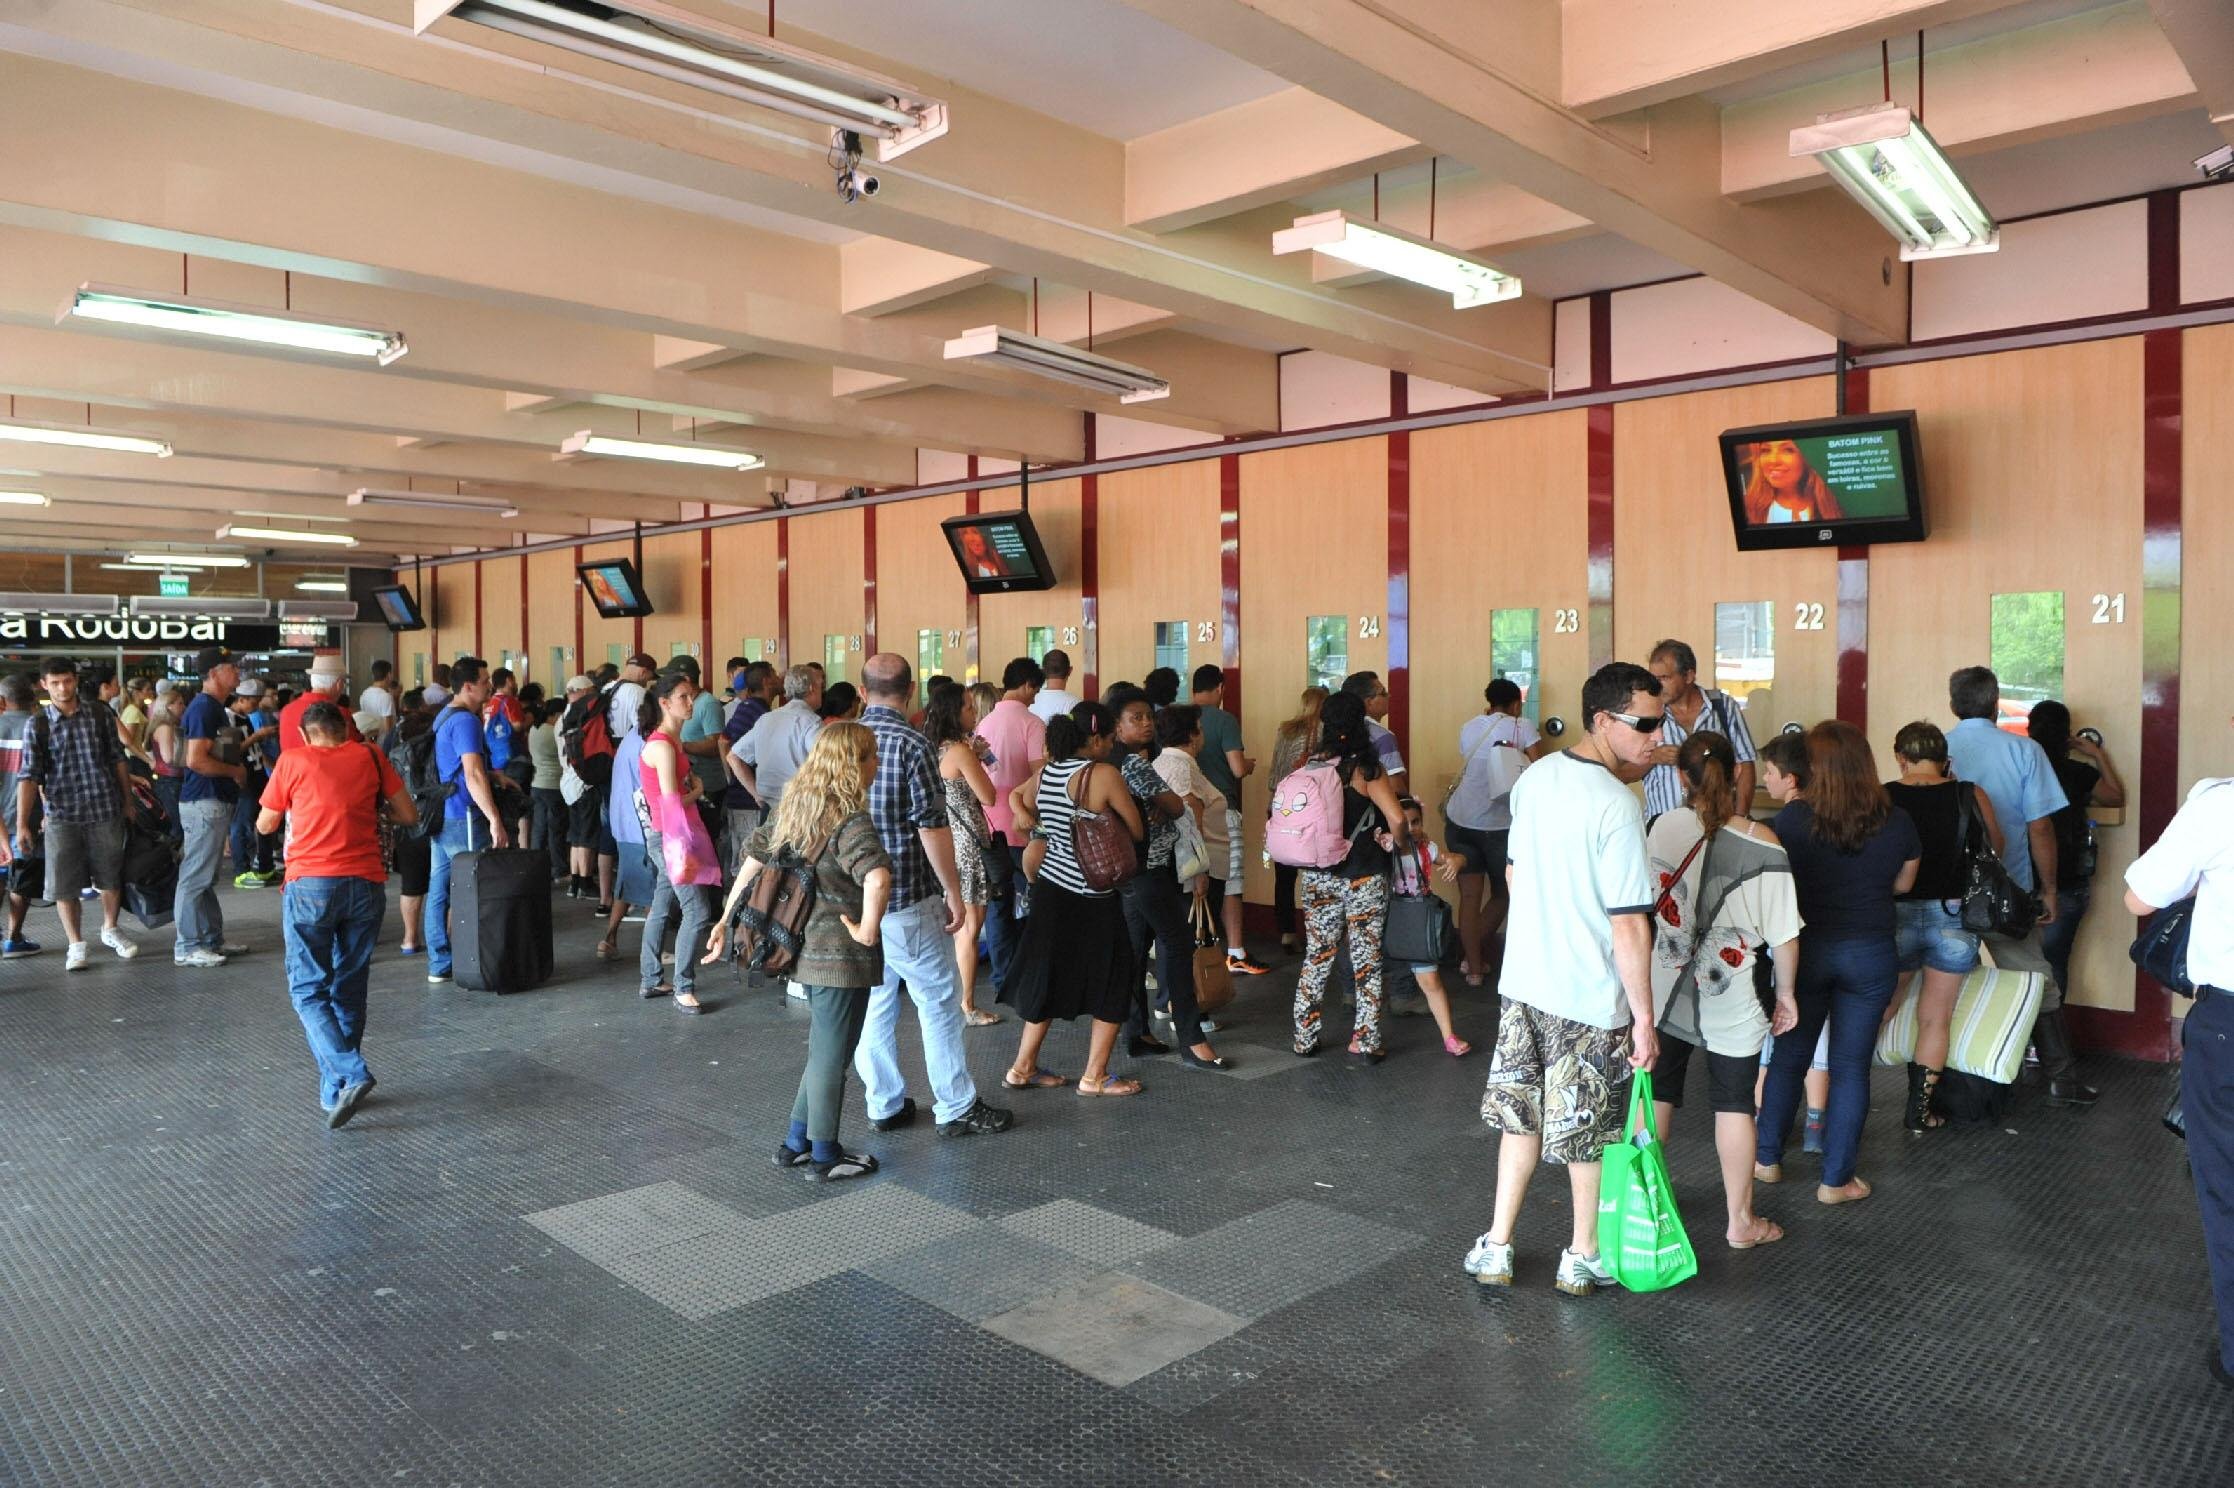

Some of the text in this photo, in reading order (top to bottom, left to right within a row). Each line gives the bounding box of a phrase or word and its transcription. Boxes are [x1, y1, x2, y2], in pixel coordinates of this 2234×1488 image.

[1828, 436, 1883, 448] BATOM PINK
[161, 582, 187, 594] SAÍDA
[1795, 602, 1824, 631] 22
[2091, 592, 2125, 624] 21
[40, 607, 232, 640] RodoBar
[1359, 616, 1379, 639] 24
[1555, 608, 1579, 633] 23
[948, 630, 961, 648] 27
[1063, 626, 1078, 646] 26
[1198, 621, 1215, 642] 25
[765, 639, 775, 654] 29
[849, 635, 861, 651] 28
